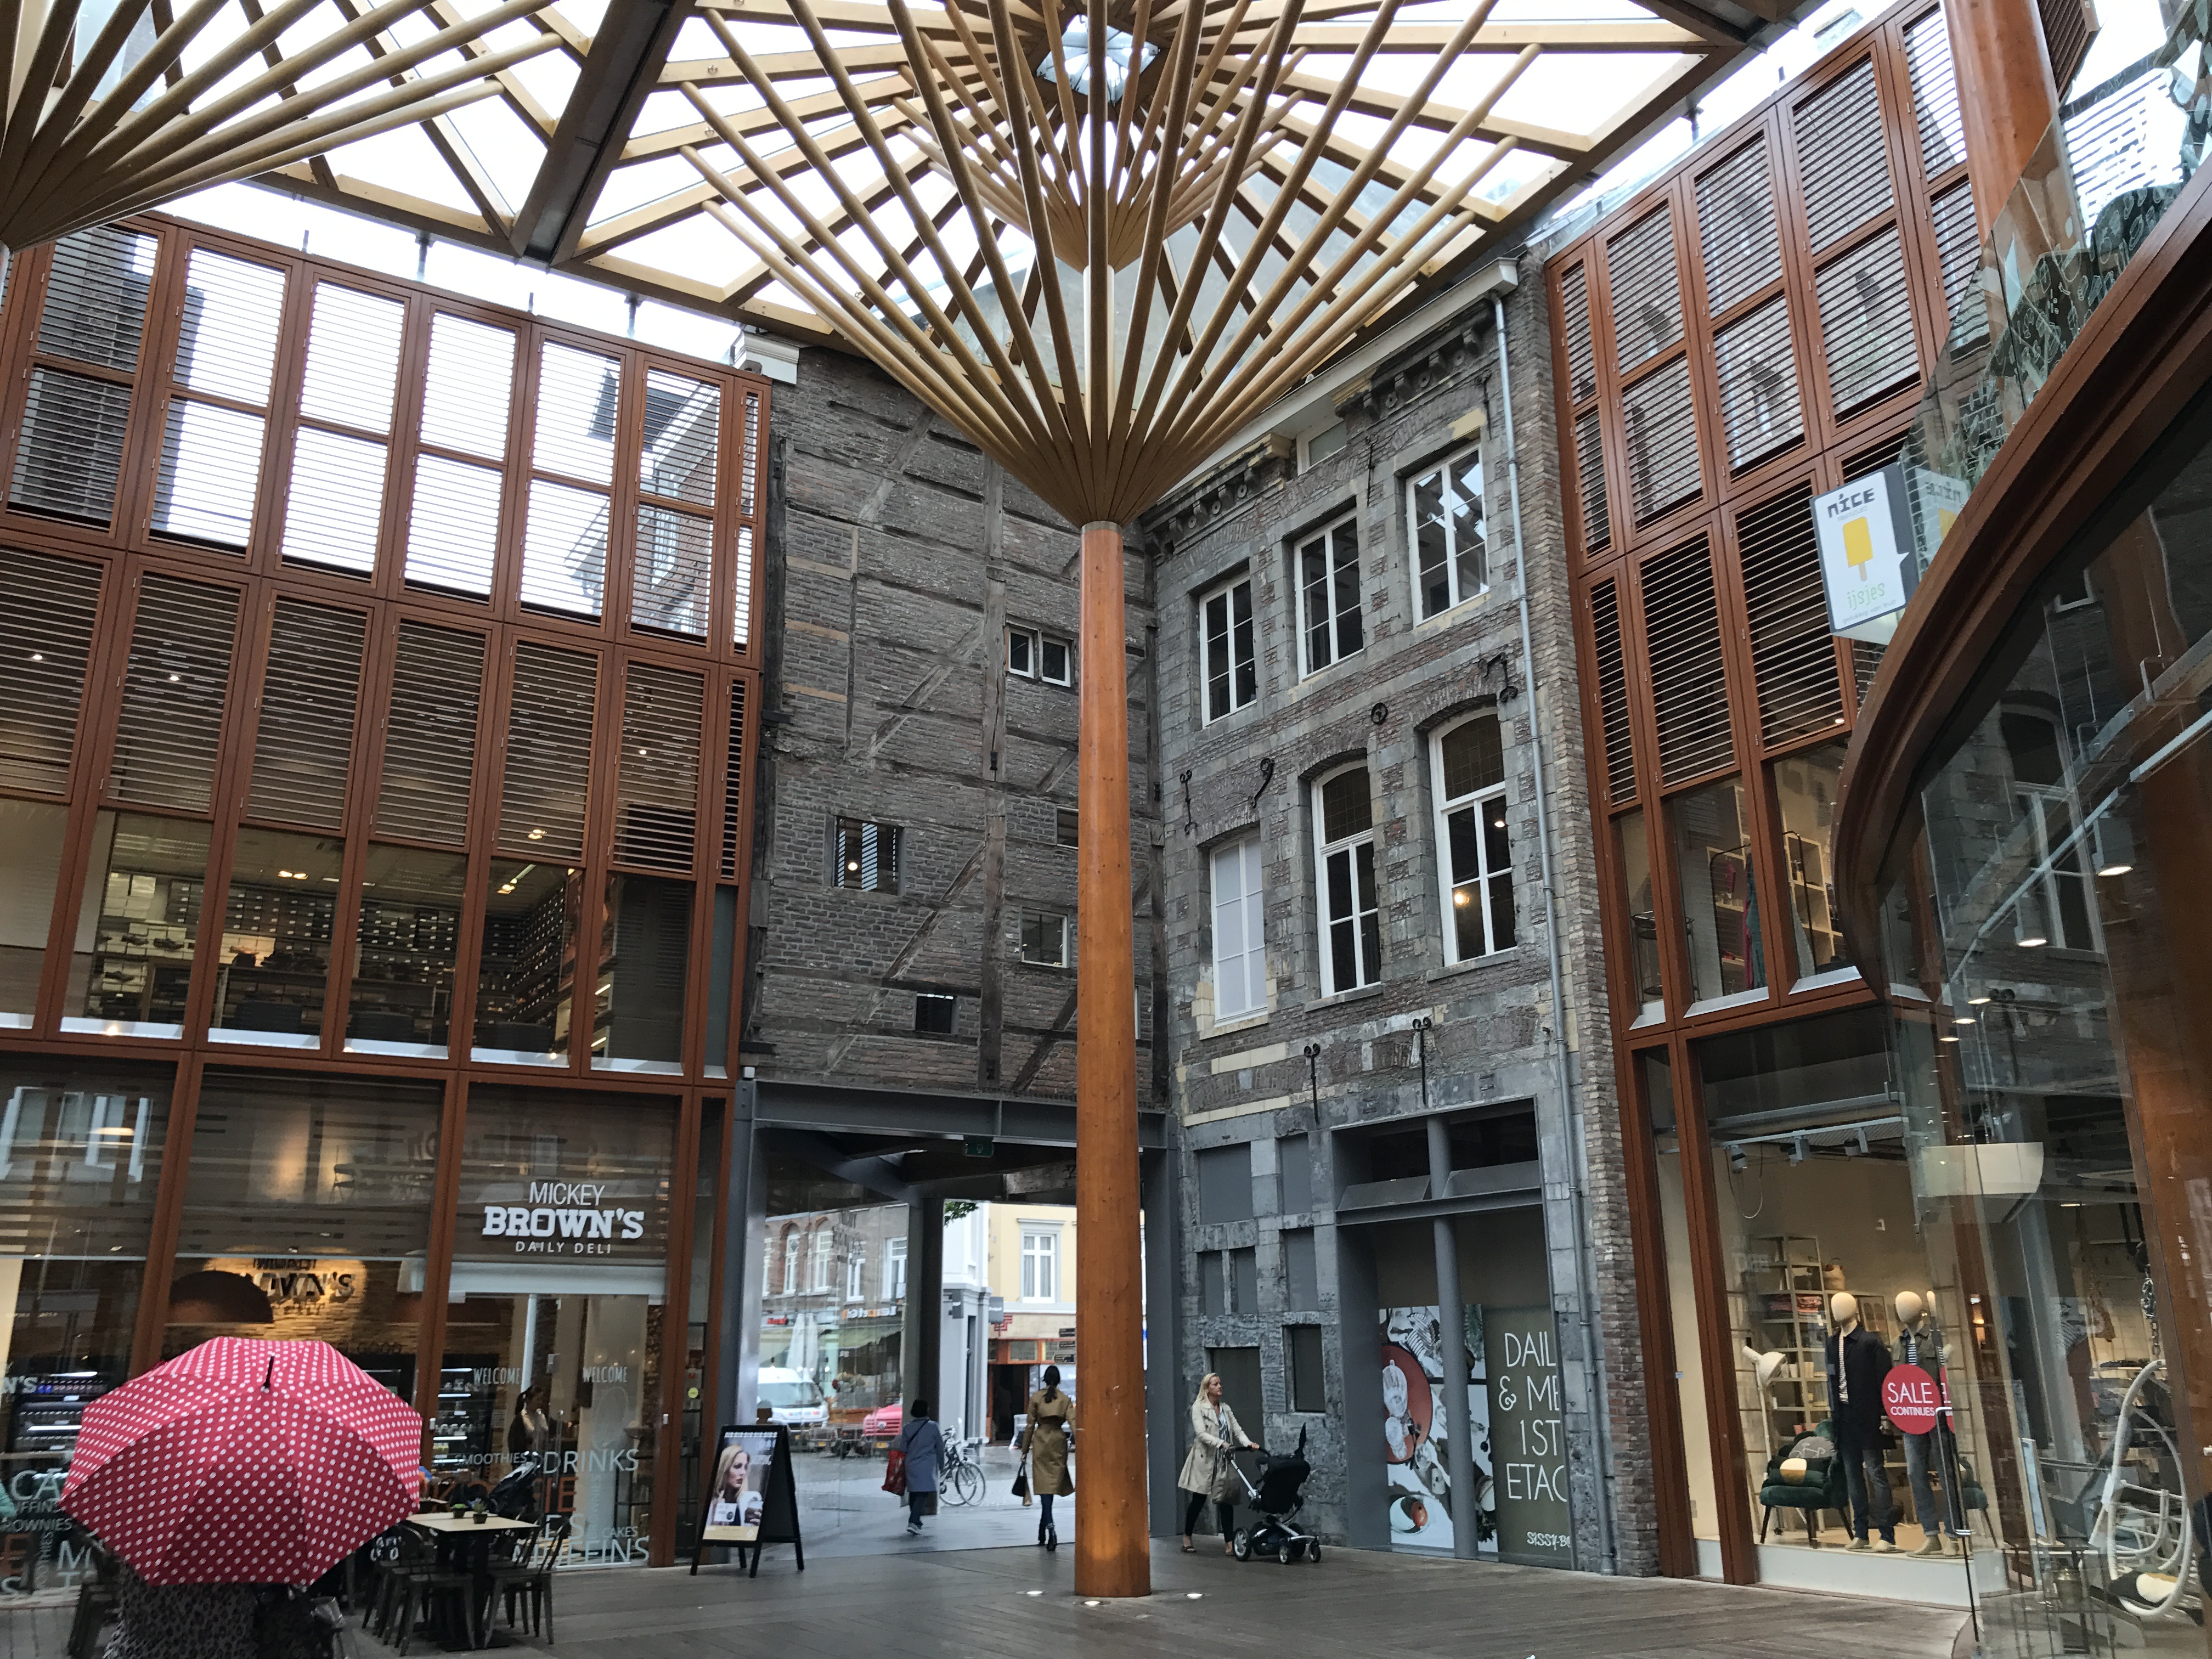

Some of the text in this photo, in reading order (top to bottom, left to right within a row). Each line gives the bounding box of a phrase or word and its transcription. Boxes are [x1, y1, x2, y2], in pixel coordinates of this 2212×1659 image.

[1847, 583, 1885, 611] ijsjes
[529, 1182, 605, 1206] MICKEY
[482, 1206, 645, 1239] BROWN'S
[515, 1241, 611, 1254] DAILY DELI
[1505, 1331, 1556, 1367] DAIL
[473, 1367, 521, 1385] WELCOME
[583, 1366, 628, 1383] WELCOME
[1499, 1375, 1516, 1410] &
[1888, 1382, 1933, 1403] SALE
[1891, 1406, 1935, 1416] CONTINUES
[454, 1452, 527, 1466] SMOOTHIES
[543, 1448, 639, 1474] DRINKS
